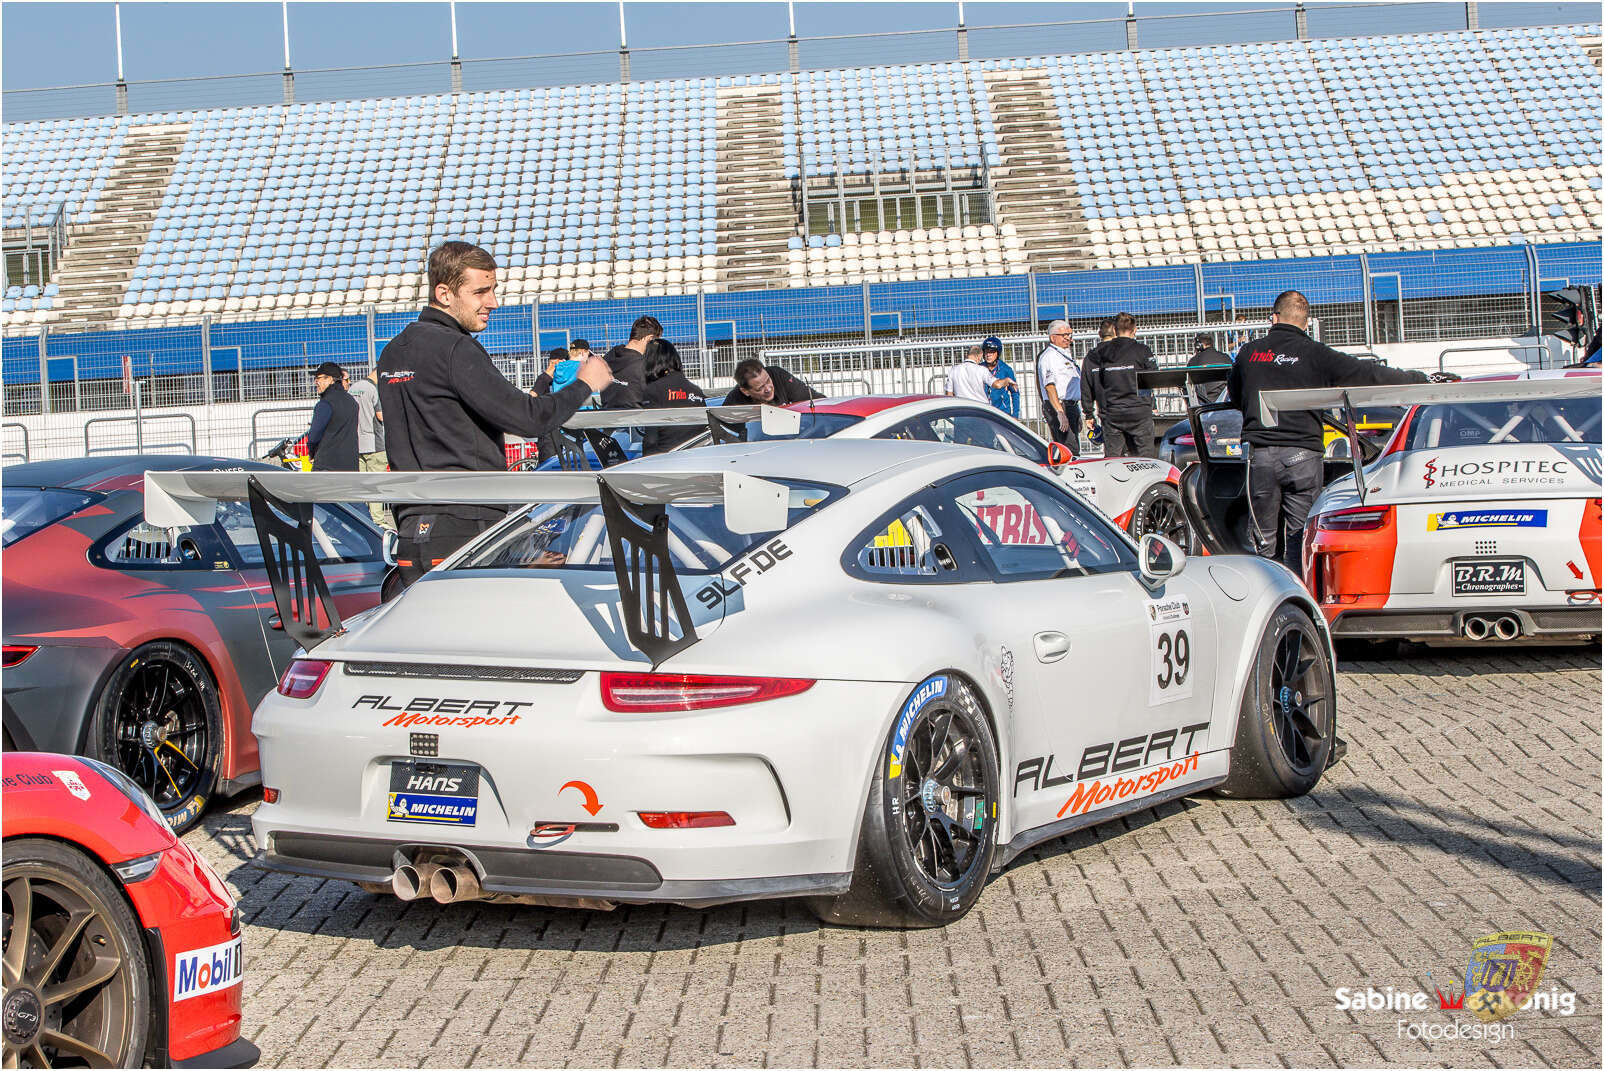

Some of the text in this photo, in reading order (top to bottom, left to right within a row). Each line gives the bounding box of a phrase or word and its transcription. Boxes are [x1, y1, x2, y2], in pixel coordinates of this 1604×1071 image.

[1441, 461, 1568, 477] HOSPITEC
[1439, 477, 1565, 488] MEDICAL SERVICES
[1460, 514, 1534, 524] MICHELIN
[695, 538, 794, 610] 9LF.DE
[1157, 629, 1190, 690] 39
[351, 695, 534, 716] ALBERT
[899, 679, 943, 741] MICHELIN
[382, 712, 524, 728] Motorsport
[1013, 721, 1210, 798] ALBERT
[16, 774, 54, 786] Club
[1056, 751, 1200, 818] Motorsport
[410, 803, 476, 817] MICHELIN
[178, 947, 232, 994] Mobil
[17, 1011, 37, 1022] GT3
